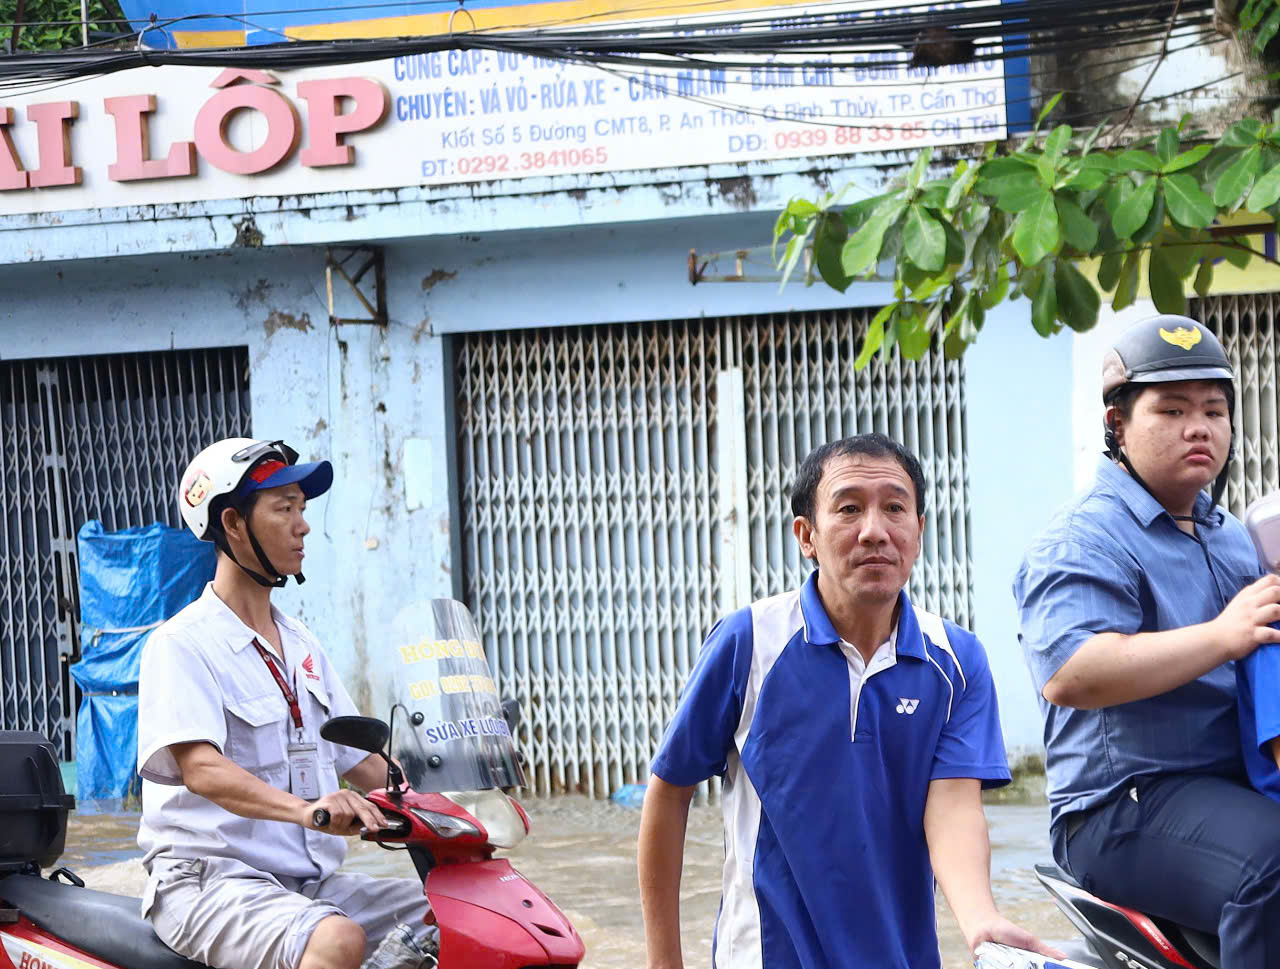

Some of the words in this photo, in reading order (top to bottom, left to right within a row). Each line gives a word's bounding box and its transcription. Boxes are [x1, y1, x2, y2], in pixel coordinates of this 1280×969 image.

[584, 79, 606, 105] XE
[513, 128, 522, 144] 5
[680, 111, 703, 129] An
[774, 128, 828, 150] 0939
[834, 125, 862, 145] 88
[868, 123, 895, 143] 33
